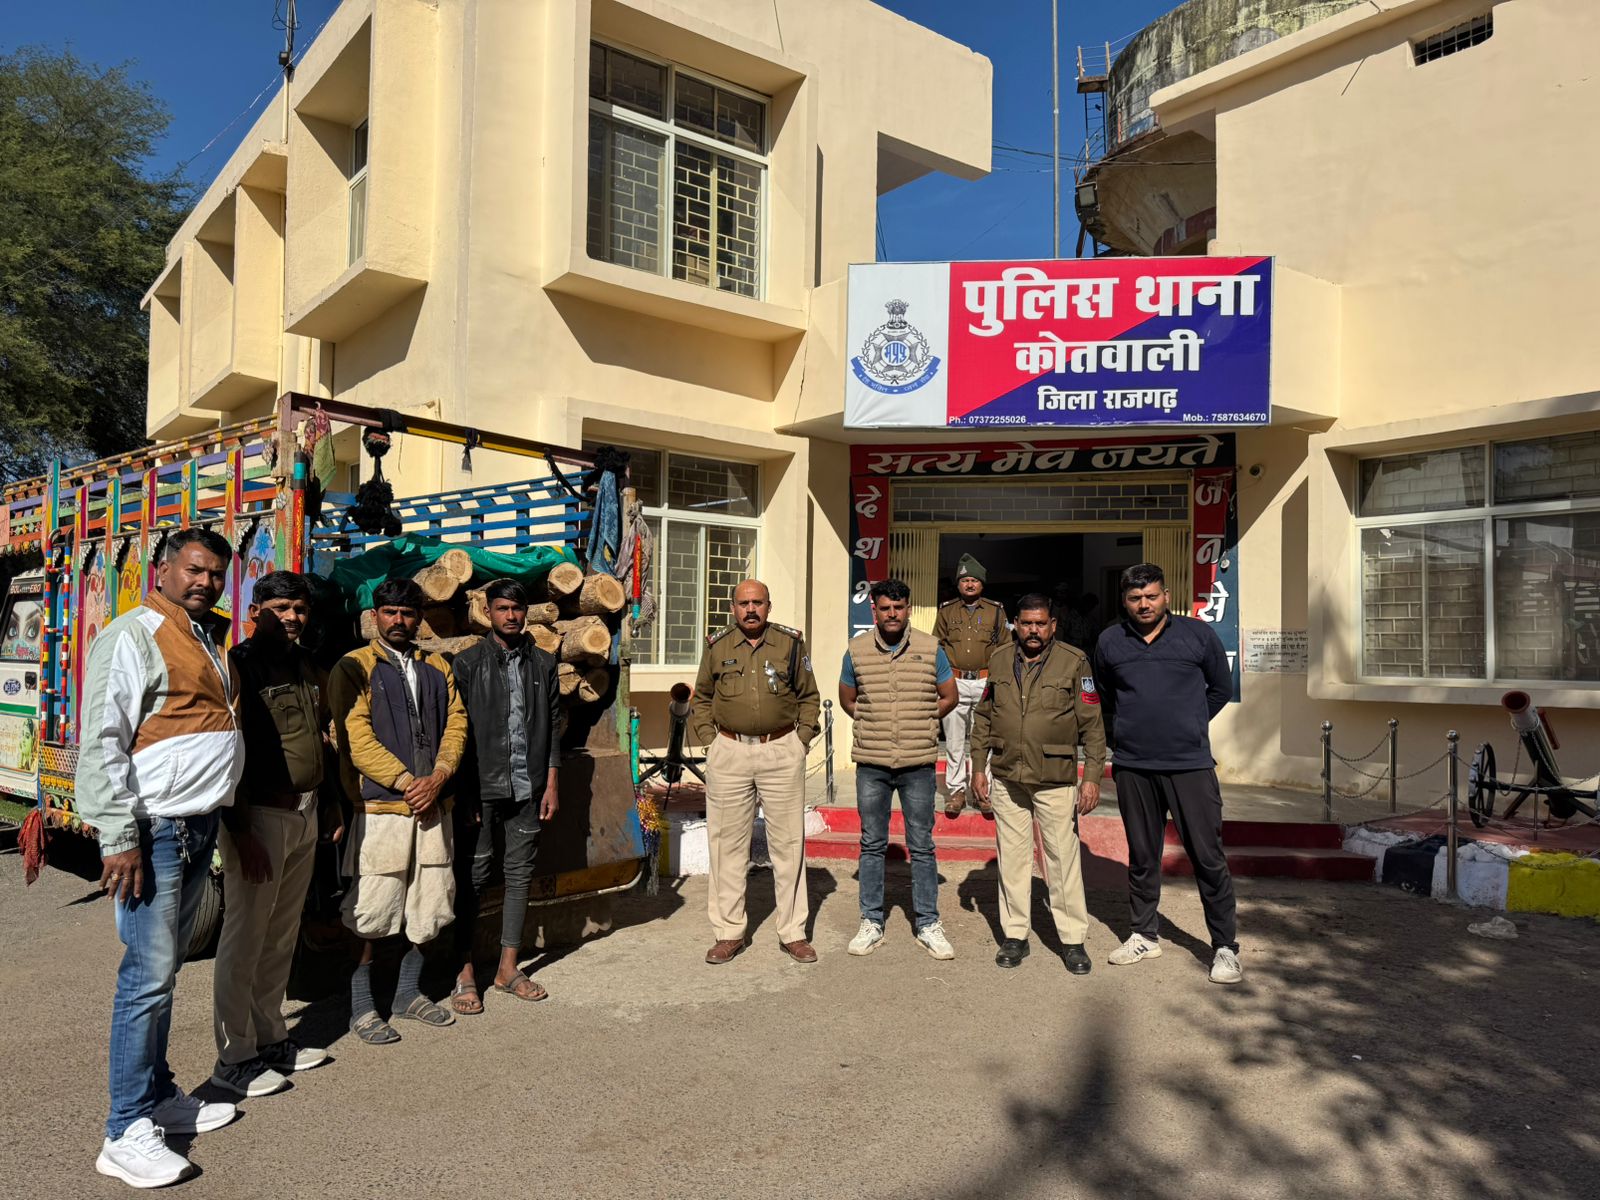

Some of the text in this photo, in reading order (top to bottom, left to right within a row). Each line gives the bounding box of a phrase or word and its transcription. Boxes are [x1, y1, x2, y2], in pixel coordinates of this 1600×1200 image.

[962, 267, 1261, 336] पुलिस थाना
[1013, 328, 1205, 374] कोतवाली
[1037, 385, 1178, 413] जिला राजगढ़
[948, 415, 1027, 424] Ph.: 07372255026
[1182, 413, 1267, 422] Mob.: 7587634670
[867, 435, 1224, 474] सत्य मेव जयते
